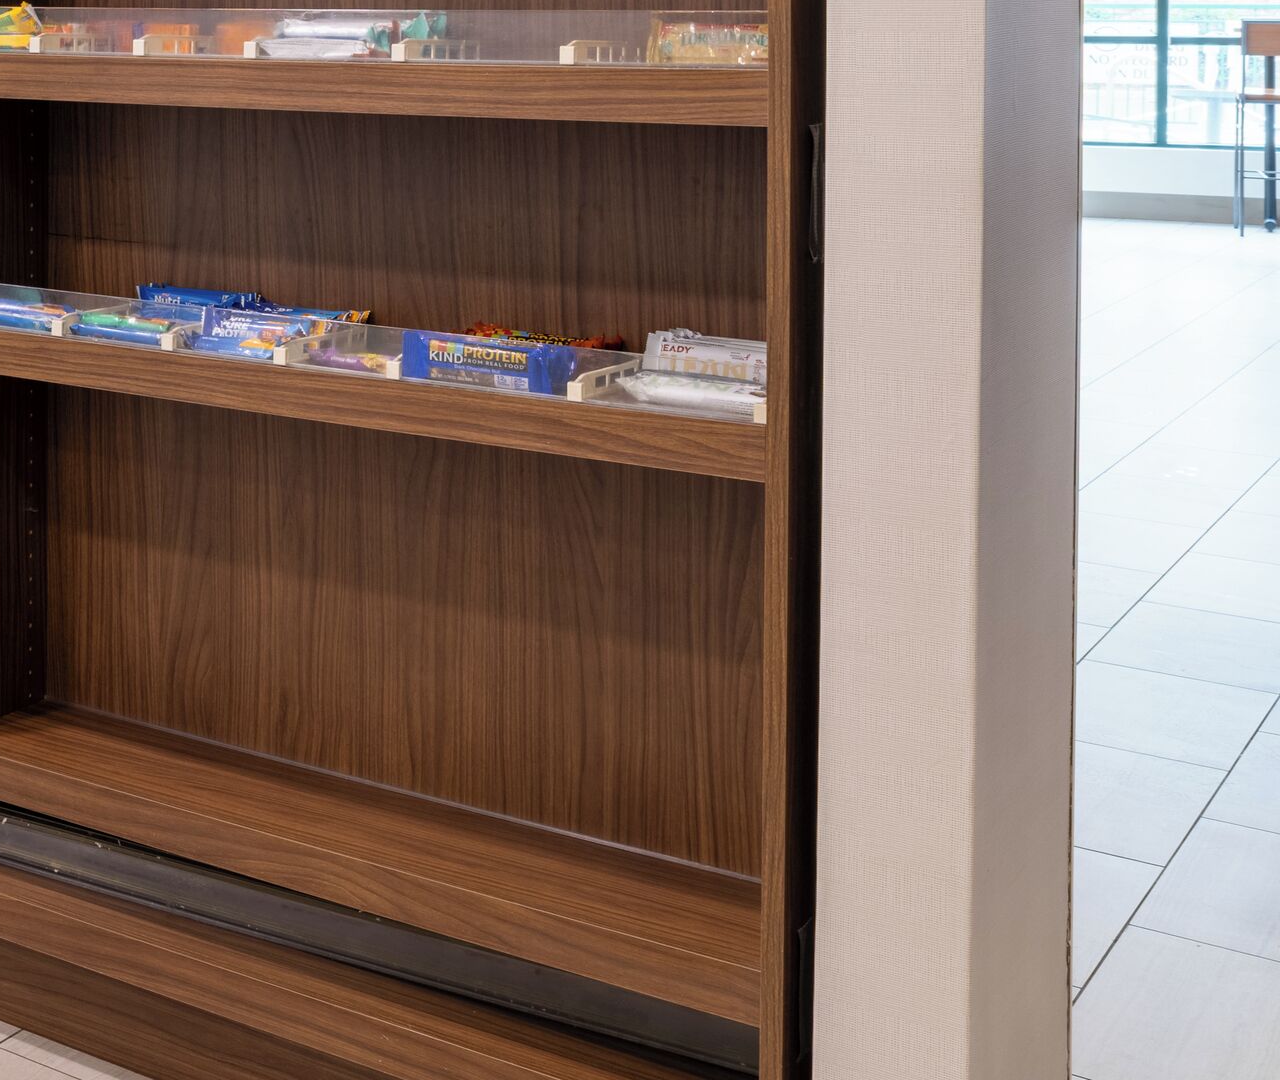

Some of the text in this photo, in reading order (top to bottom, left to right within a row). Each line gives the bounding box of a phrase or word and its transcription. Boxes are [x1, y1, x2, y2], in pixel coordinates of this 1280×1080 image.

[429, 351, 464, 365] KIND
[463, 347, 528, 365] PROTEIN
[485, 360, 501, 368] REAL
[504, 362, 525, 370] FOOD
